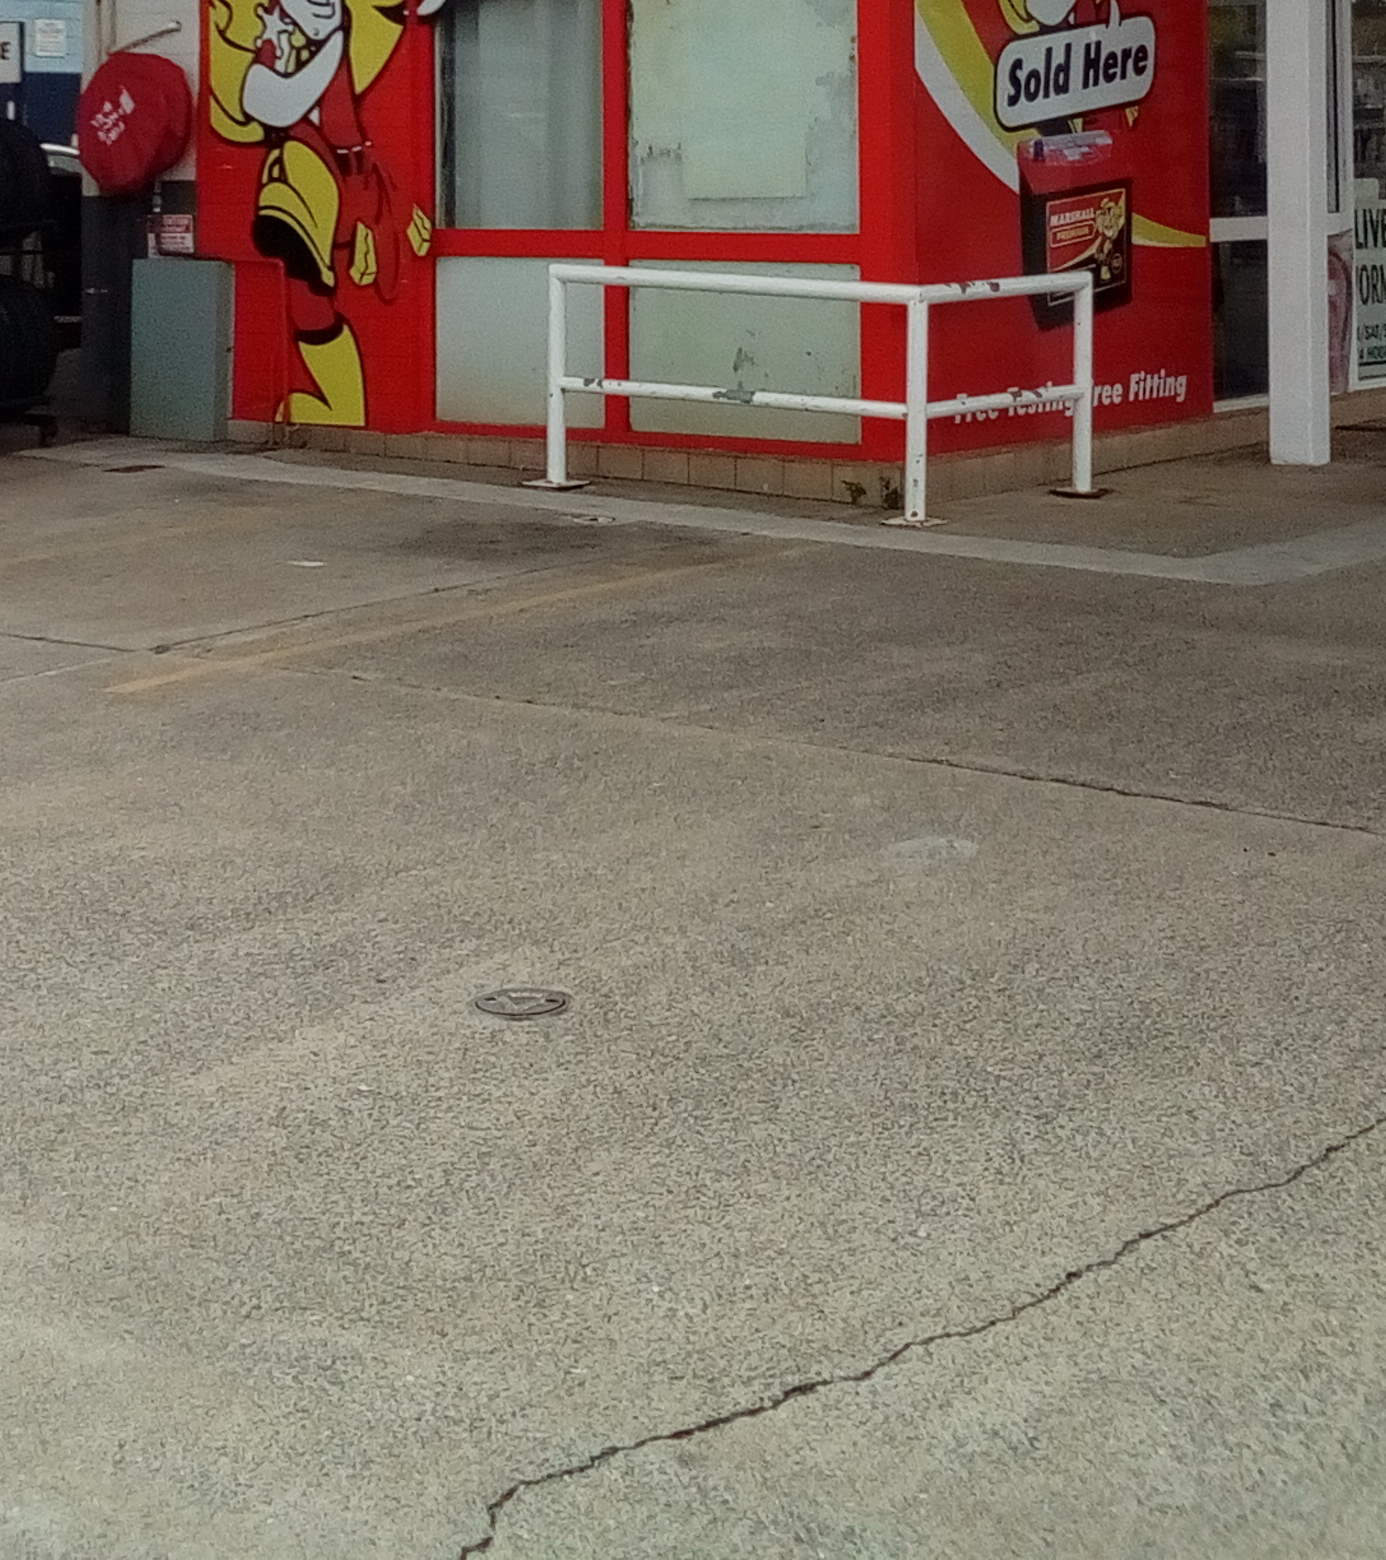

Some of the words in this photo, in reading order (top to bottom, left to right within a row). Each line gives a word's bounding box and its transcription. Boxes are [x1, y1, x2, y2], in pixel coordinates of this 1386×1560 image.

[1007, 42, 1071, 108] Sold
[1082, 38, 1150, 89] Here
[1092, 380, 1124, 407] ree
[1129, 368, 1187, 404] Fitting
